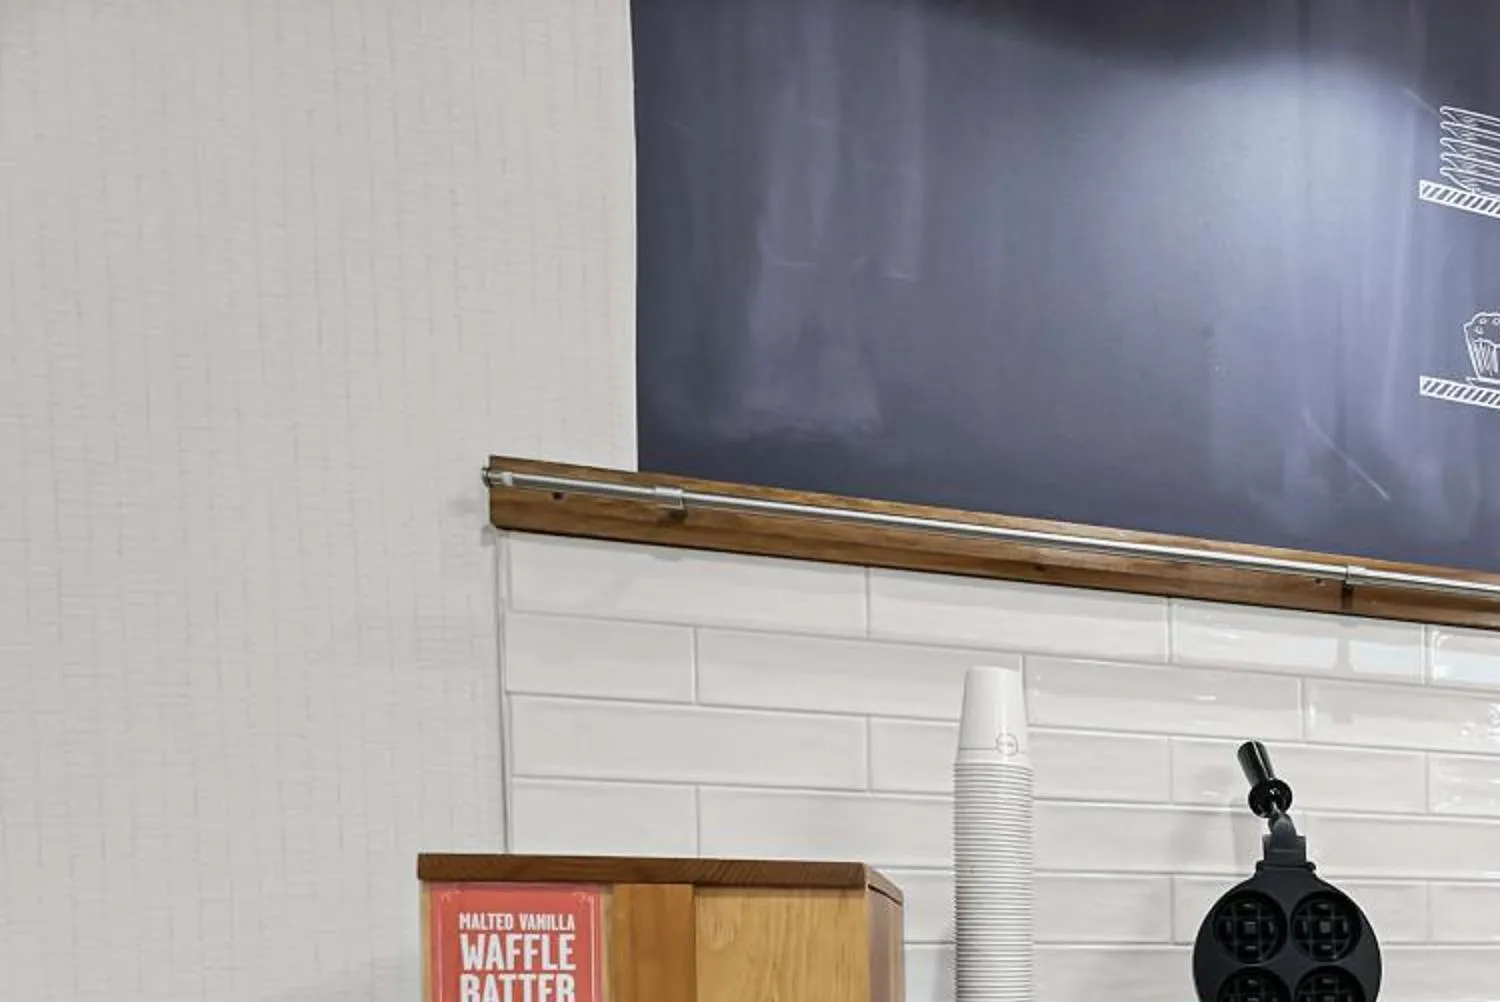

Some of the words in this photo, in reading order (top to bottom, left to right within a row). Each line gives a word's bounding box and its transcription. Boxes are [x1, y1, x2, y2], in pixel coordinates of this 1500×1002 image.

[459, 913, 514, 931] MALTED
[519, 913, 576, 931] VANILLA
[460, 933, 577, 971] WAFFLE
